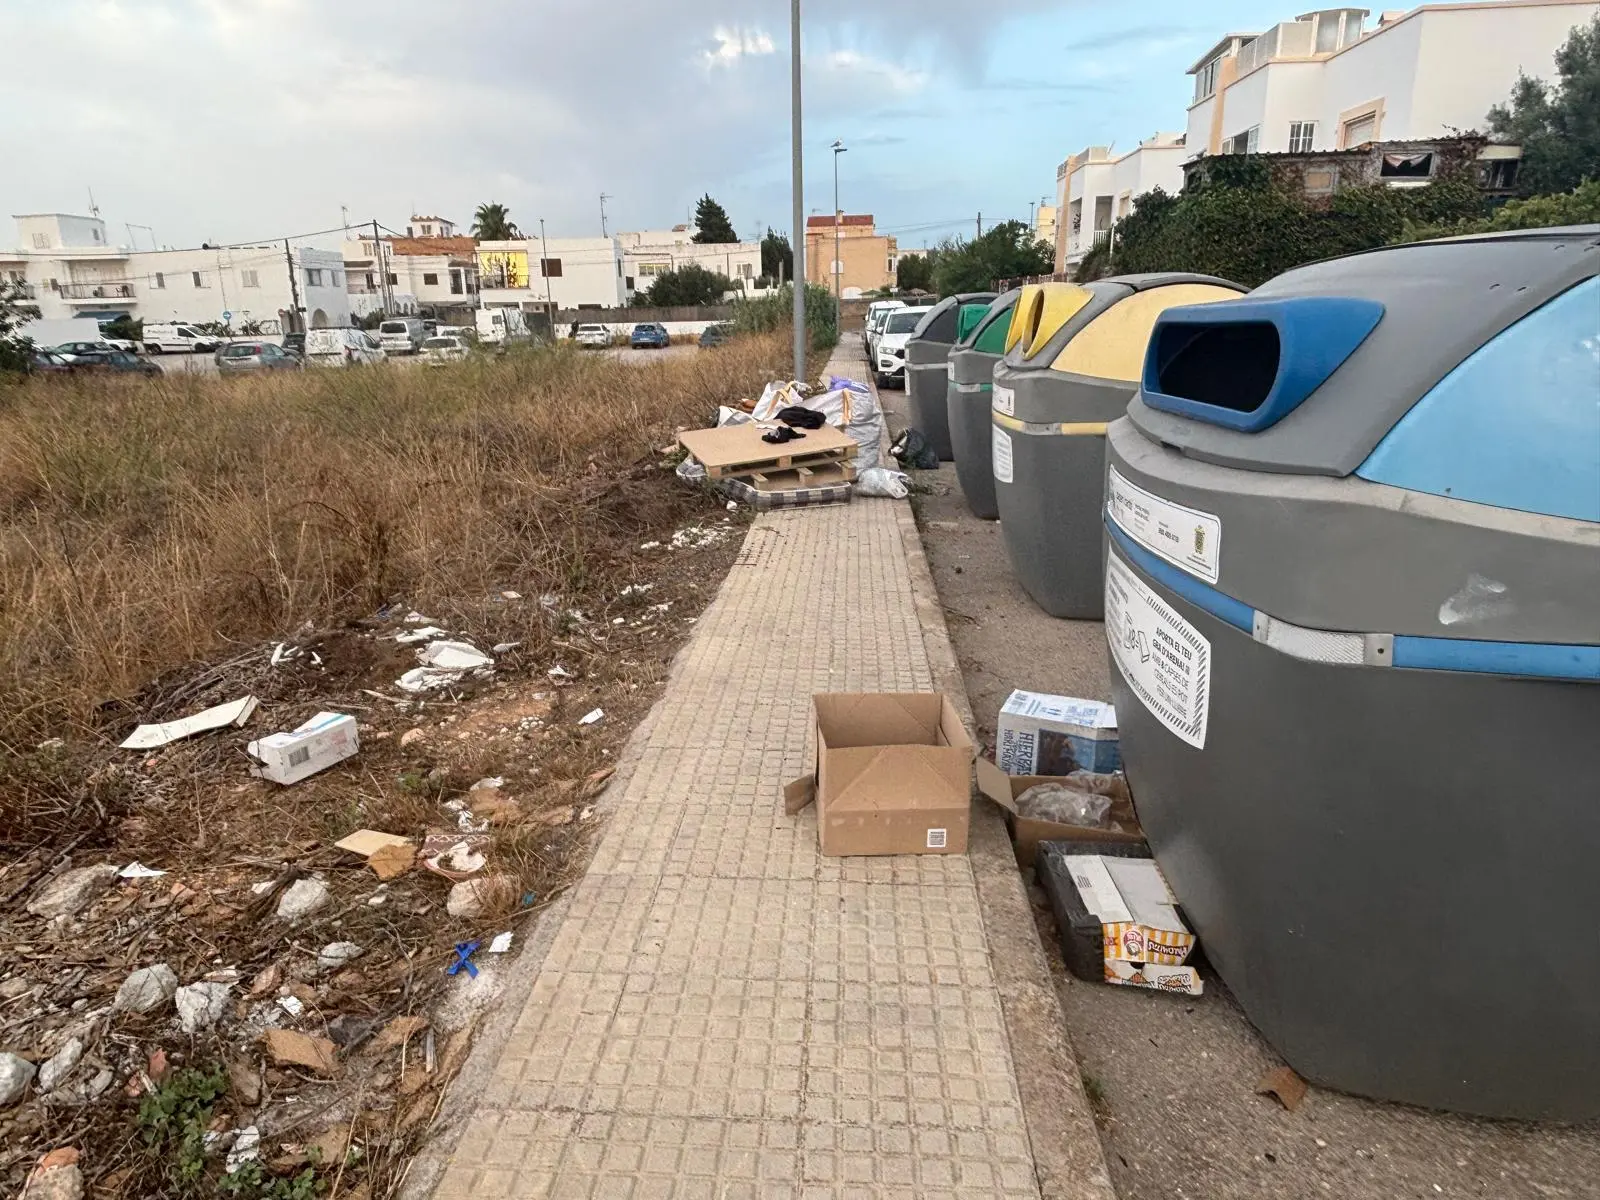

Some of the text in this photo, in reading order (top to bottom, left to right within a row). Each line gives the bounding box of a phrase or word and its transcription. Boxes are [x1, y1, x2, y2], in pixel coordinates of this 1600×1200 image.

[1156, 627, 1192, 661] APORTA EL TEU
[1016, 731, 1034, 776] HIERBAS
